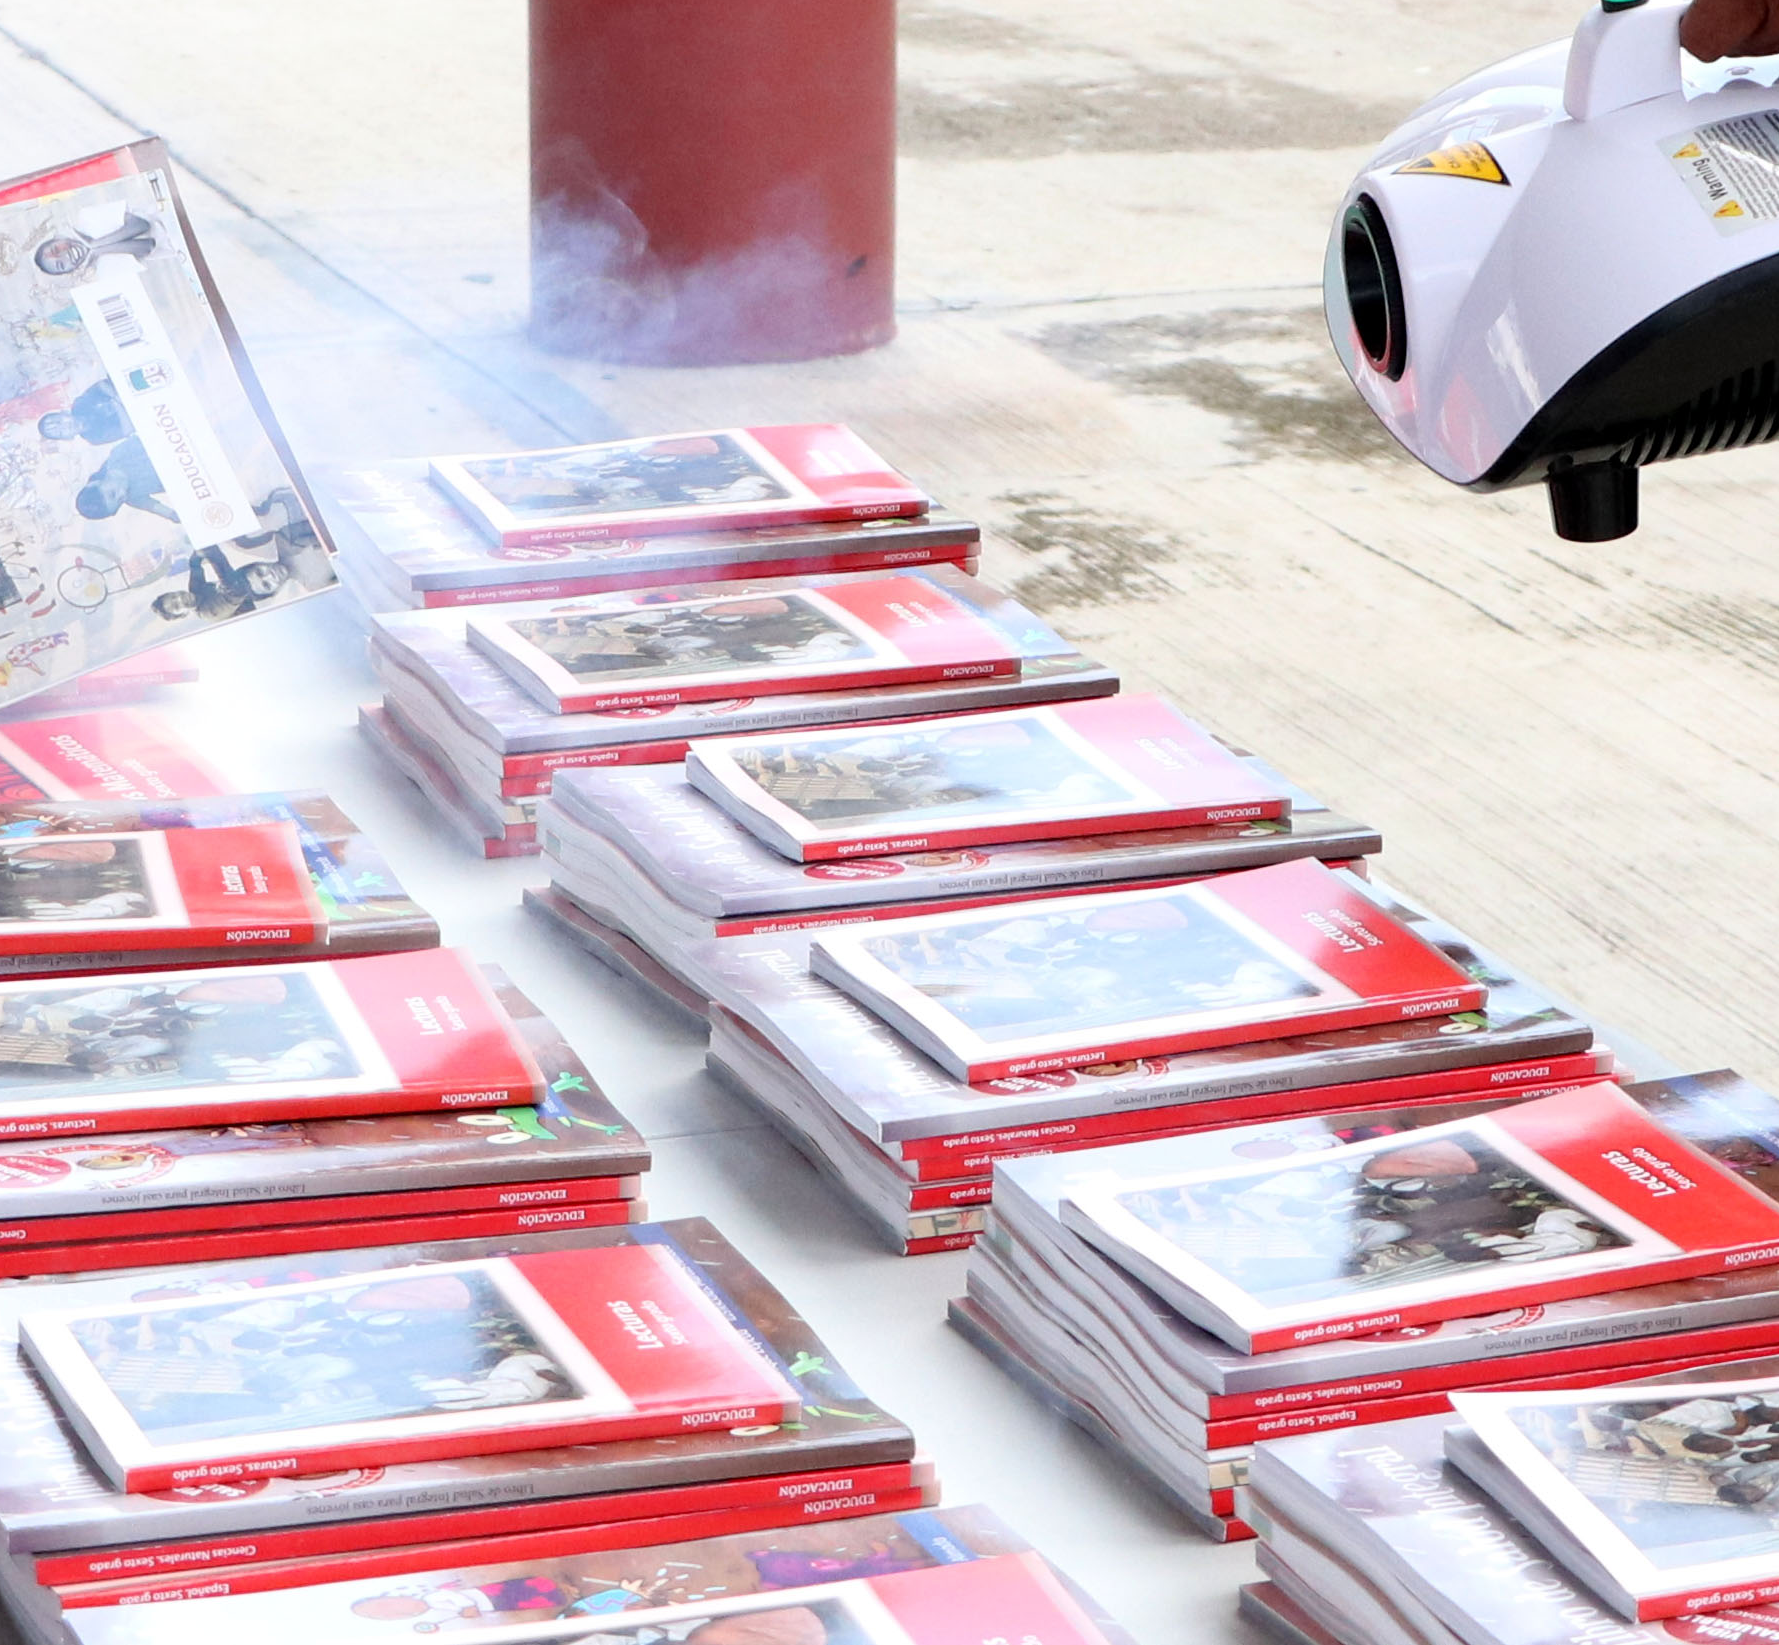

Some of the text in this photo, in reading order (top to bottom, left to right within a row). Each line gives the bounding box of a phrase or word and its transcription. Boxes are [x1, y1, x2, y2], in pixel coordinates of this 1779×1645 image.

[1691, 157, 1728, 201] Warning
[153, 403, 212, 500] EDUCACIÓN
[853, 504, 901, 516] EDUCACIÓN
[530, 527, 609, 542] Lecturas. Sexto grado
[884, 549, 931, 562] EDUCACIÓN
[456, 591, 478, 601] grado
[943, 664, 995, 678] EDUCACIÓN
[595, 692, 680, 708] Lecturas. Sexto grado
[542, 756, 565, 767] grado
[566, 755, 588, 765] Sexto
[1206, 807, 1262, 821] EDUCACIÓN
[837, 838, 928, 855] Lecturas. Sexto grado
[220, 865, 247, 896] Lecturas
[971, 878, 989, 889] casi
[989, 874, 1009, 886] para
[1009, 872, 1044, 886] Integral
[1069, 870, 1082, 880] de
[938, 877, 970, 892] jóvenes
[226, 928, 291, 943] EDUCACIÓN
[753, 923, 800, 935] Sexto grado
[1300, 910, 1365, 953] Lecturas
[1354, 927, 1385, 947] Sexto
[404, 996, 444, 1036] Lecturas
[435, 995, 469, 1031] Sexto grado
[1402, 998, 1460, 1017] EDUCACIÓN
[1009, 1052, 1105, 1075] Lecturas. Sexto grado
[1490, 1066, 1550, 1083] EDUCACIÓN
[1190, 1085, 1227, 1099] Integral
[1230, 1082, 1255, 1094] Salud
[1257, 1079, 1268, 1089] de
[441, 1090, 509, 1106] EDUCACIÓN
[1114, 1093, 1148, 1107] jóvenes
[1150, 1091, 1168, 1102] casi
[1169, 1087, 1188, 1101] para
[18, 1122, 48, 1135] Sexto
[49, 1119, 96, 1132] Lecturas.
[943, 1124, 1076, 1149] Ciencias Naturales. Sexto grado
[964, 1156, 993, 1168] grado
[1632, 1147, 1698, 1190] Sexto grado
[1601, 1150, 1677, 1198] Lecturas
[101, 1184, 306, 1205] Libro de Salud Integral para casi jóvenes
[499, 1189, 567, 1204] EDUCACIÓN
[949, 1189, 976, 1201] grado
[518, 1210, 585, 1226] EDUCACIÓN
[944, 1236, 969, 1248] grado
[606, 1300, 664, 1350] Lecturas
[641, 1300, 689, 1346] Sexto grado
[1294, 1313, 1401, 1342] Lecturas. Sexto grado
[1484, 1316, 1683, 1353] Libro de Salud Integral para casi jóvenes
[1255, 1379, 1403, 1408] Ciencias Naturales. Sexto grado
[682, 1407, 756, 1427] EDUCACIÓN
[1257, 1409, 1358, 1433] Español. Sexto grado
[173, 1457, 298, 1481] Lecturas. Sexto grado
[779, 1478, 853, 1499] EDUCACIÓN
[1336, 1446, 1484, 1517] Integral
[306, 1483, 535, 1518] Libro de Salud Integral para casi jóvenes
[803, 1493, 876, 1515] EDUCACIÓN
[89, 1544, 257, 1574] Ciencias Naturales. Sexto grado
[119, 1582, 230, 1606] Español. Sexto grado
[1513, 1578, 1577, 1603] de
[1723, 1587, 1756, 1604] Sexto
[1686, 1591, 1722, 1609] grado
[1695, 1625, 1742, 1641] VIDA
